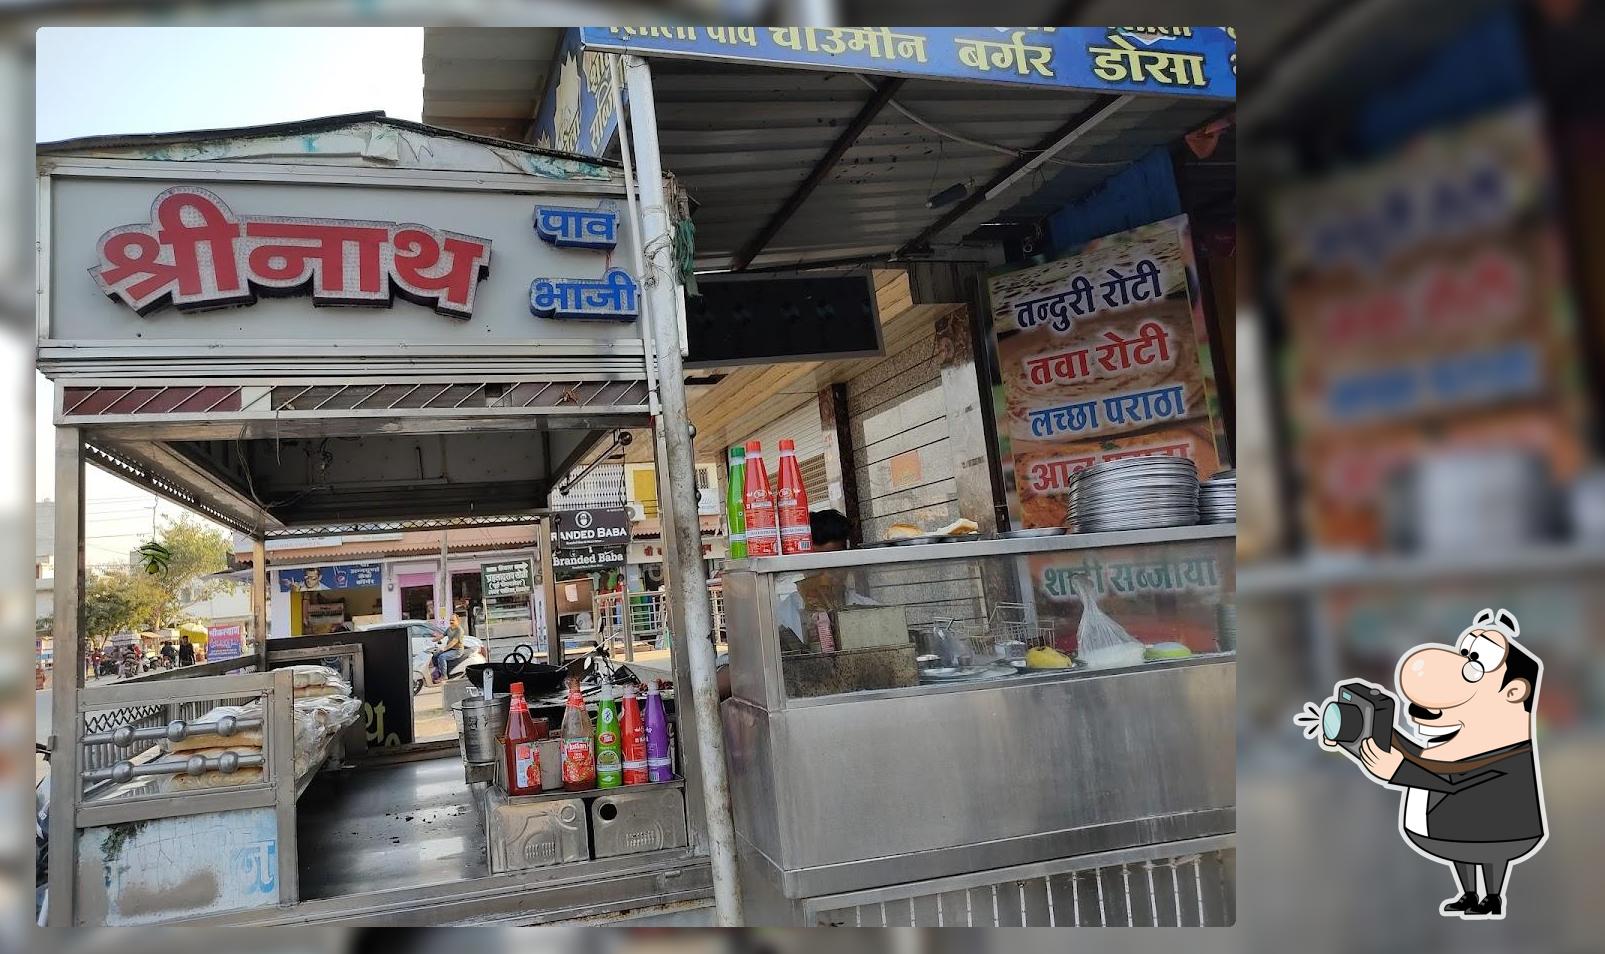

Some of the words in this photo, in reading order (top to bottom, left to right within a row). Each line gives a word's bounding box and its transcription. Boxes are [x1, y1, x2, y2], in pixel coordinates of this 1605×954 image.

[954, 30, 1054, 78] बर्गर
[1088, 34, 1208, 87] डोसा
[98, 190, 487, 308] श्रीनाथ
[536, 205, 617, 244] पाव
[534, 268, 640, 315] भाजी
[1014, 275, 1096, 332] तन्दुरी
[1099, 259, 1163, 308] रोटी
[1027, 349, 1090, 386] तवा
[1095, 321, 1170, 372] रोटी
[1028, 400, 1099, 437] लच्छा
[1102, 385, 1186, 424] पराठा
[551, 530, 595, 541] RANDED
[596, 527, 628, 538] BABA
[552, 554, 597, 567] Branded
[598, 552, 624, 563] Baba
